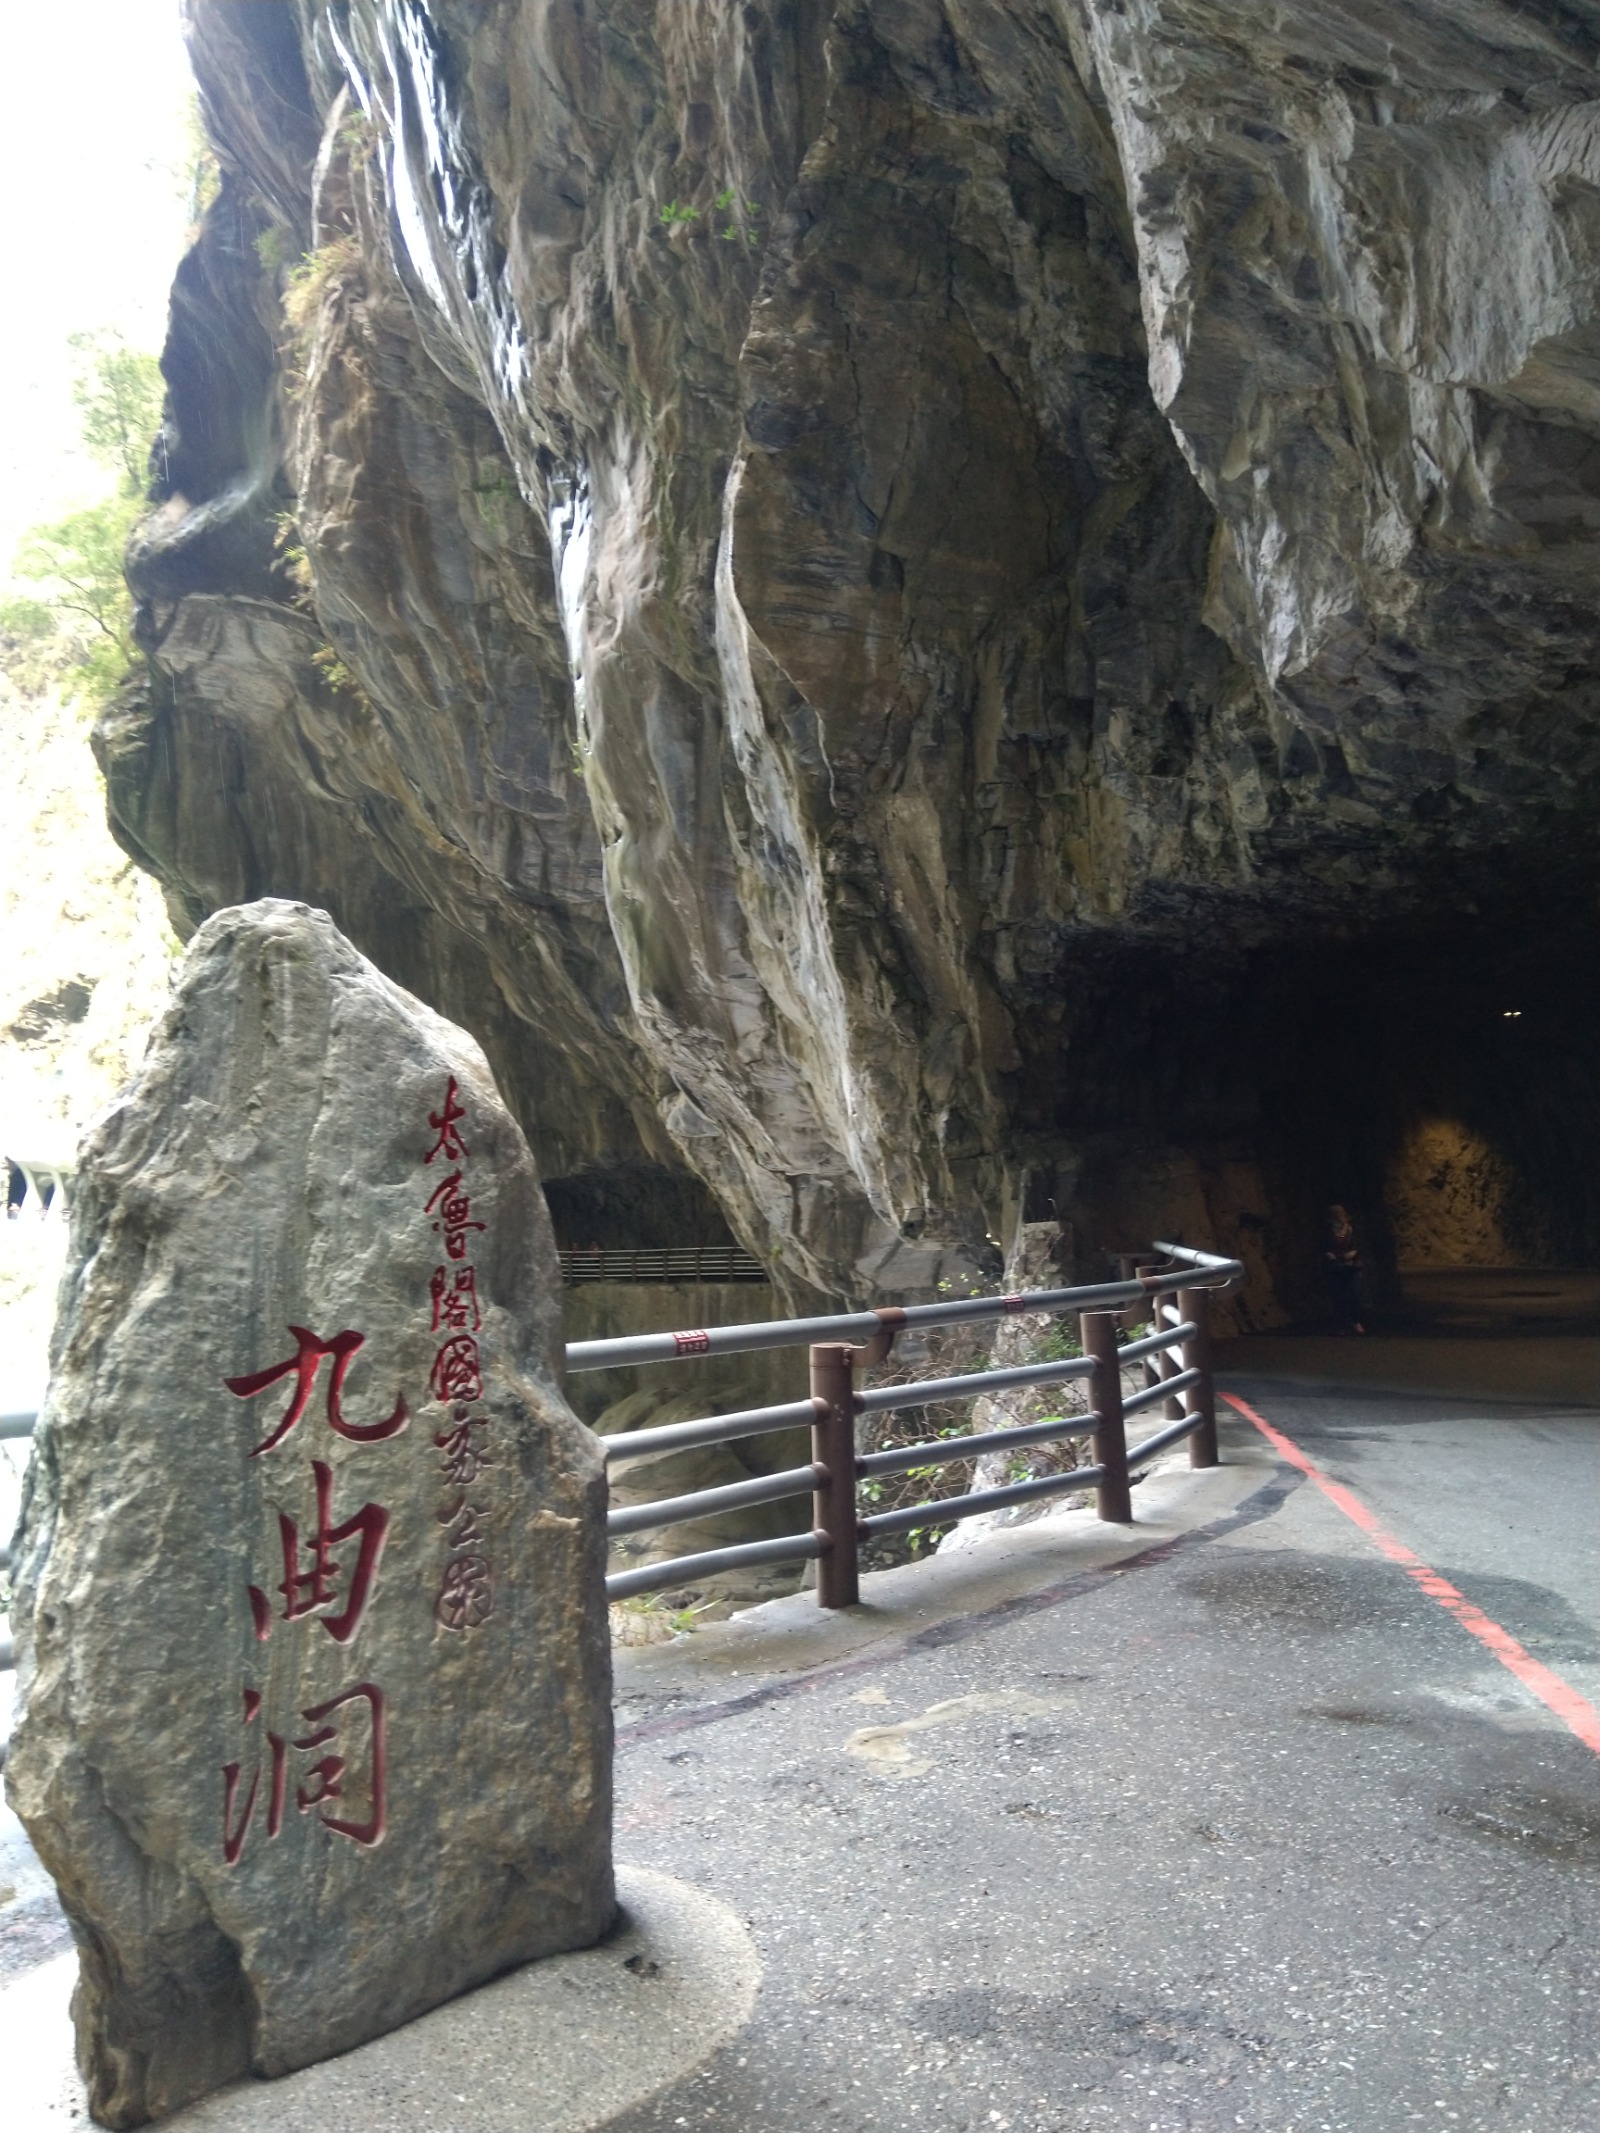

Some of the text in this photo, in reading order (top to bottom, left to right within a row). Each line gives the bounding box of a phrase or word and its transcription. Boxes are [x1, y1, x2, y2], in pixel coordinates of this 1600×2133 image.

[223, 1325, 409, 1865] 九曲洞
[423, 1075, 495, 1631] 太魯閣國家公園
